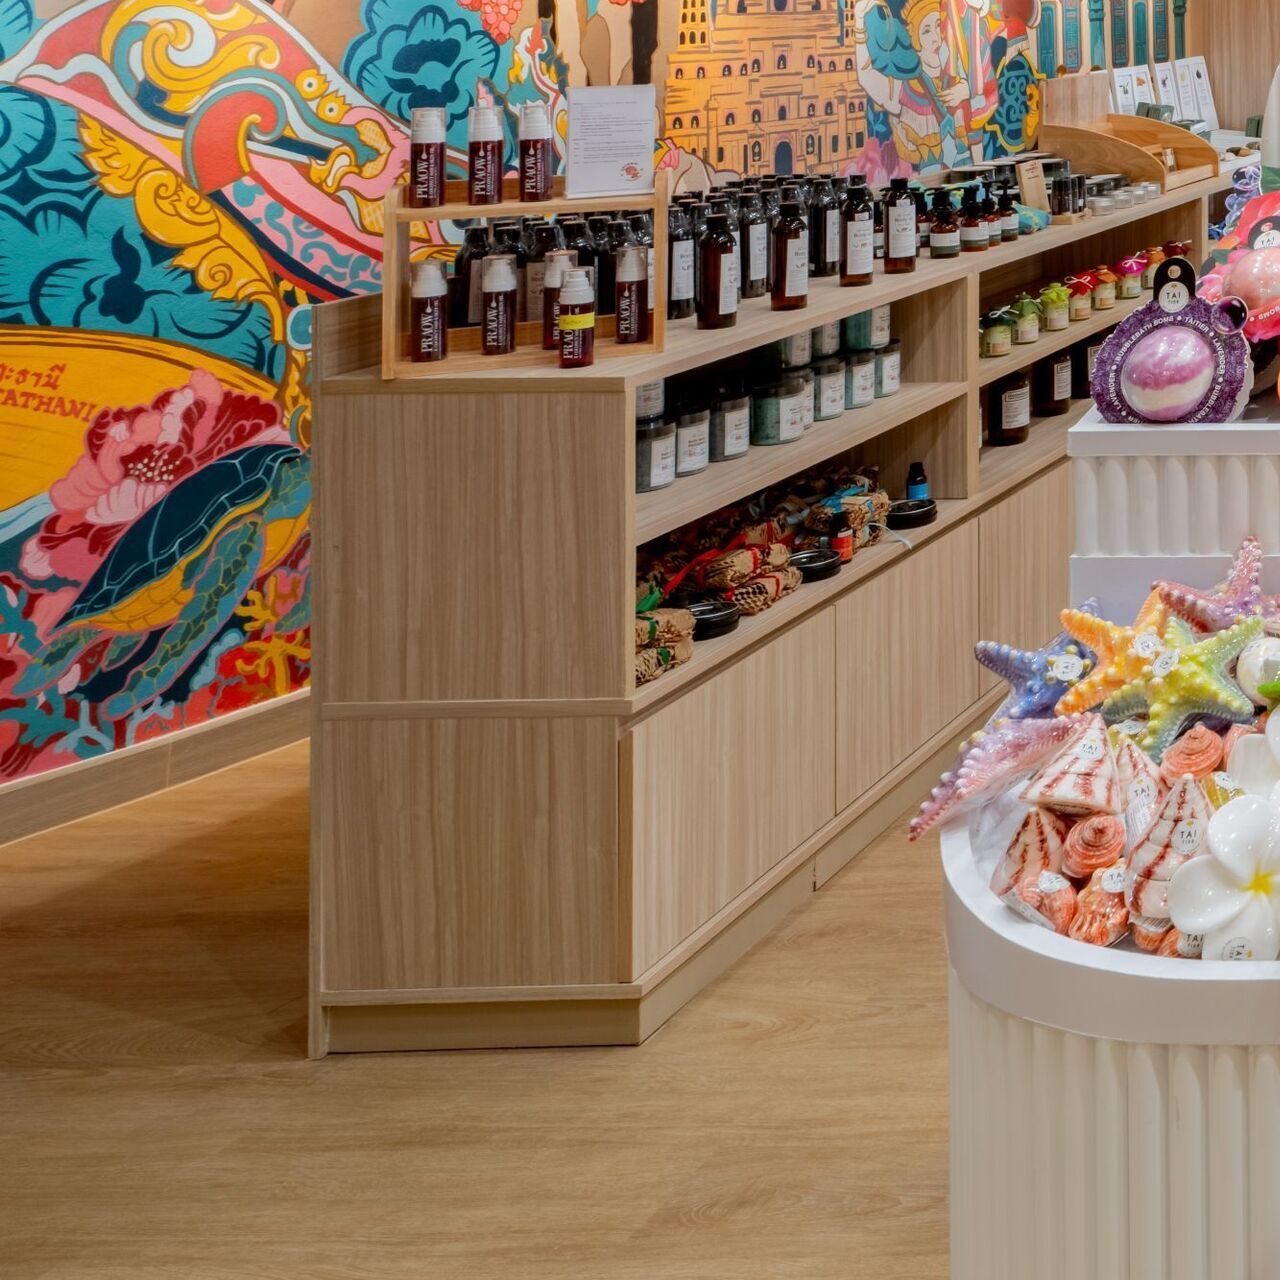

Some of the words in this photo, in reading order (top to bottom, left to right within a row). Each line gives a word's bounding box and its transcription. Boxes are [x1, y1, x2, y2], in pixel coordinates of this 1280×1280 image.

[416, 160, 428, 198] PRAOW
[474, 157, 486, 195] PRAOW
[524, 155, 536, 192] PRAOW
[421, 313, 433, 352] PRAOW
[486, 308, 498, 346] PRAOW
[619, 296, 631, 334] PRAOW
[1185, 317, 1209, 333] TAITIER
[563, 330, 573, 359] PRAO
[1116, 322, 1152, 364] BUBBLEBATH
[1151, 315, 1174, 327] BOMB
[1213, 338, 1226, 375] LAVENDER
[1108, 372, 1122, 411] LAVENDER
[1181, 830, 1197, 839] TAI
[1186, 934, 1204, 943] TAI
